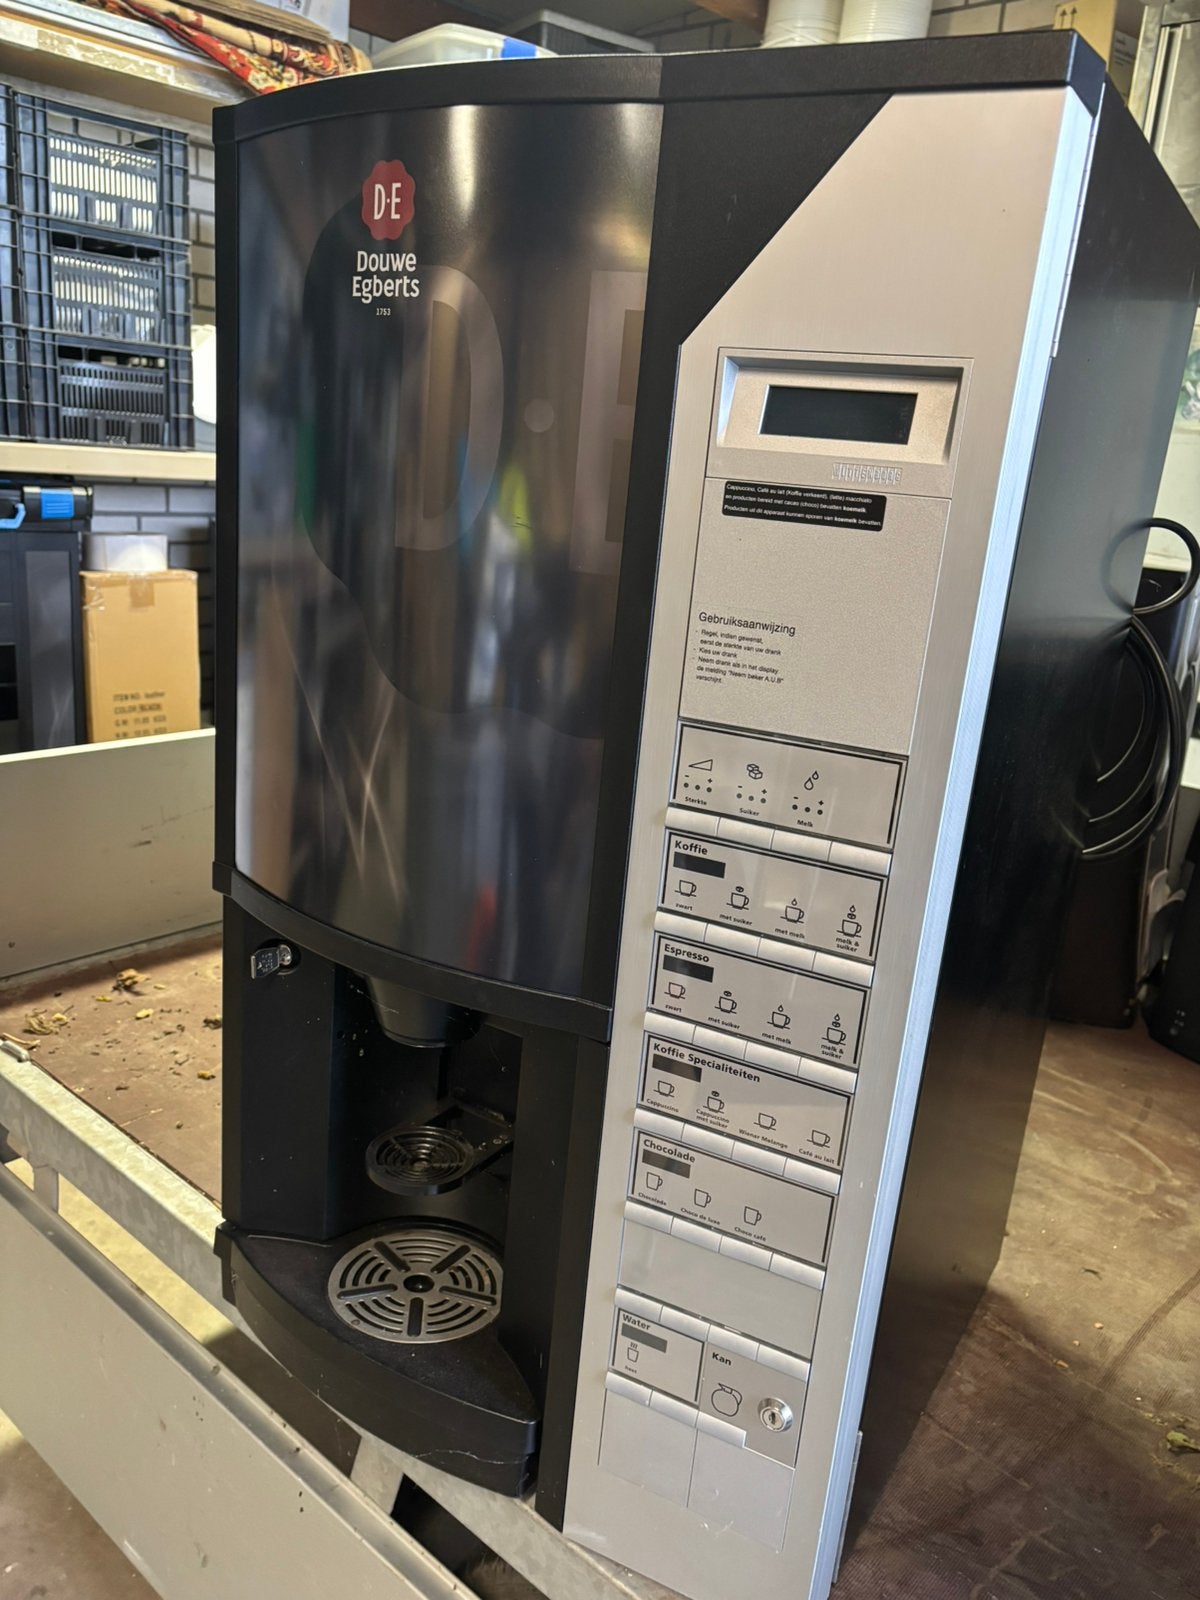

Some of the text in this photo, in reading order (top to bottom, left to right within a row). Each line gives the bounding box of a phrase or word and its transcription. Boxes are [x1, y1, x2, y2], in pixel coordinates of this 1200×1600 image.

[357, 250, 417, 272] Douwe
[352, 275, 420, 304] Egberts
[376, 308, 391, 316] 1753
[724, 504, 749, 512] Producten
[800, 501, 819, 509] (choco)
[699, 611, 796, 637] Gebruiksaanwijzing
[699, 647, 711, 655] Kies
[723, 642, 742, 650] sterkte
[698, 656, 714, 664] Neem
[758, 665, 778, 675] display
[705, 667, 727, 676] melding
[684, 796, 707, 806] Sterkte
[739, 807, 760, 817] Suiker
[797, 819, 814, 828] Melk
[675, 840, 708, 855] Koffie
[675, 903, 693, 911] zwart
[733, 917, 752, 926] suiker
[775, 928, 805, 939] met melk
[836, 937, 852, 946] melk
[664, 943, 710, 963] Espresso
[836, 943, 857, 953] suiker
[665, 1004, 682, 1013] zwart
[708, 1016, 741, 1030] met suiker
[762, 1032, 792, 1045] met melk
[820, 1043, 837, 1053] melk
[821, 1050, 842, 1060] suiker
[653, 1043, 760, 1082] Koffie Specialiteiten
[646, 1098, 679, 1113] Cappuccino
[696, 1108, 730, 1123] Cappuccino
[696, 1115, 728, 1129] met suiker
[739, 1128, 788, 1149] Wiener Melange
[643, 1139, 696, 1163] Chocolade
[798, 1148, 813, 1157] Café
[824, 1155, 835, 1165] lait
[638, 1192, 667, 1206] Chocolade
[680, 1207, 698, 1217] Choco
[734, 1226, 752, 1237] Choco
[622, 1313, 651, 1331] Water
[712, 1352, 732, 1366] Kan
